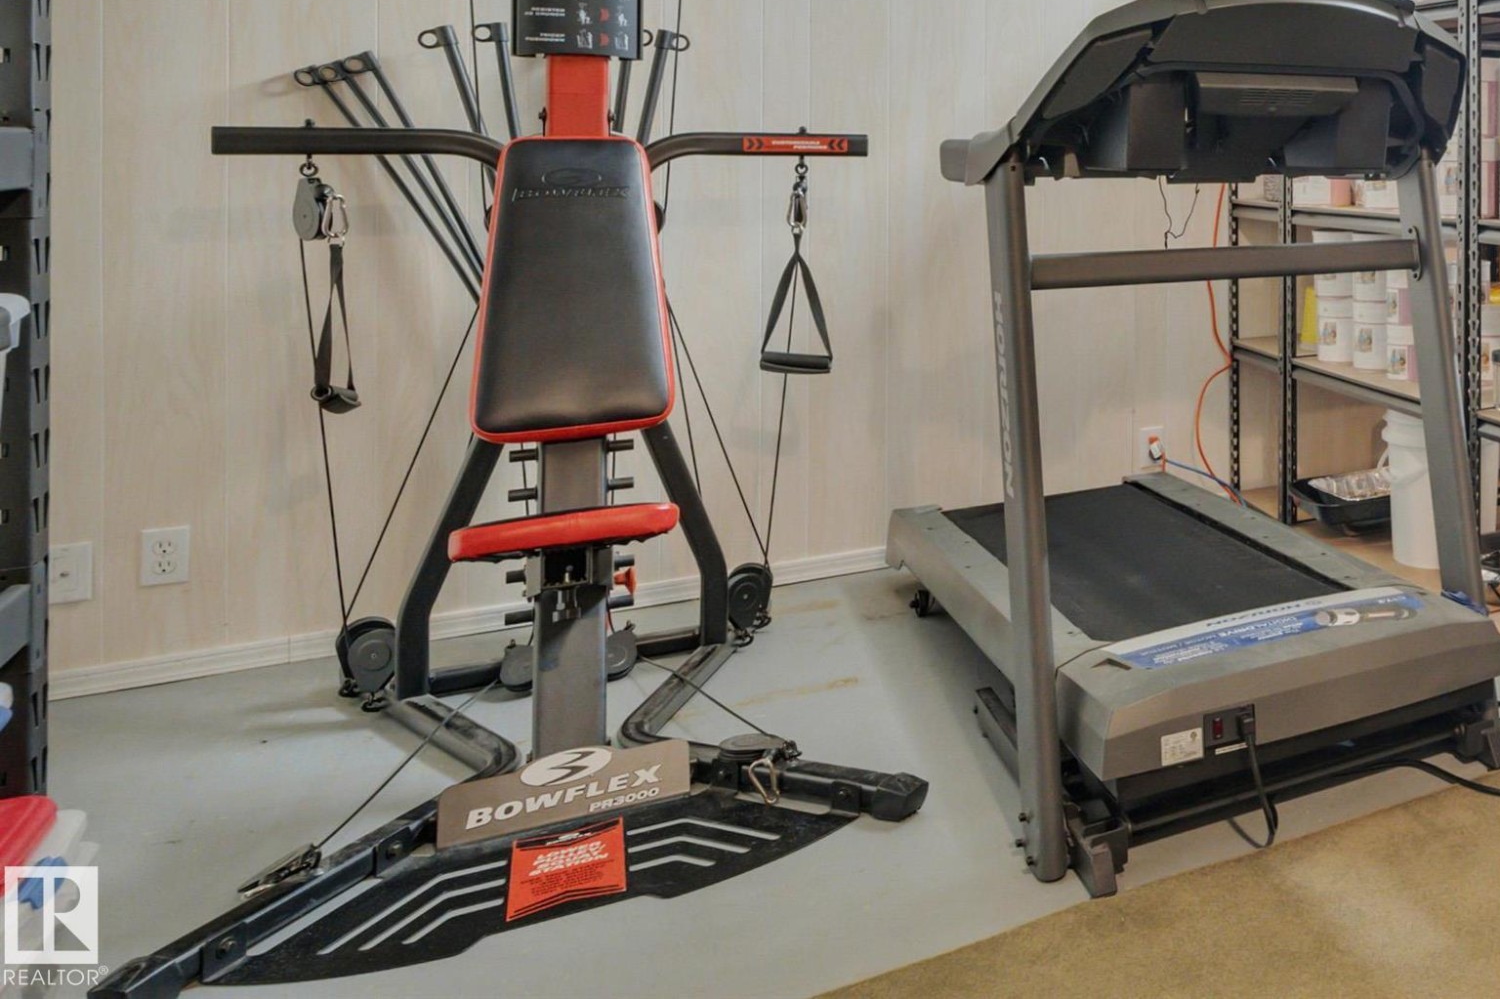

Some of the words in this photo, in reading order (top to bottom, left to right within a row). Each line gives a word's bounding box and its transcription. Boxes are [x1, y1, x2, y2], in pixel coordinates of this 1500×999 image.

[993, 291, 1015, 499] HORIZON
[464, 764, 662, 830] BOWFLEX
[588, 786, 661, 813] PR3000
